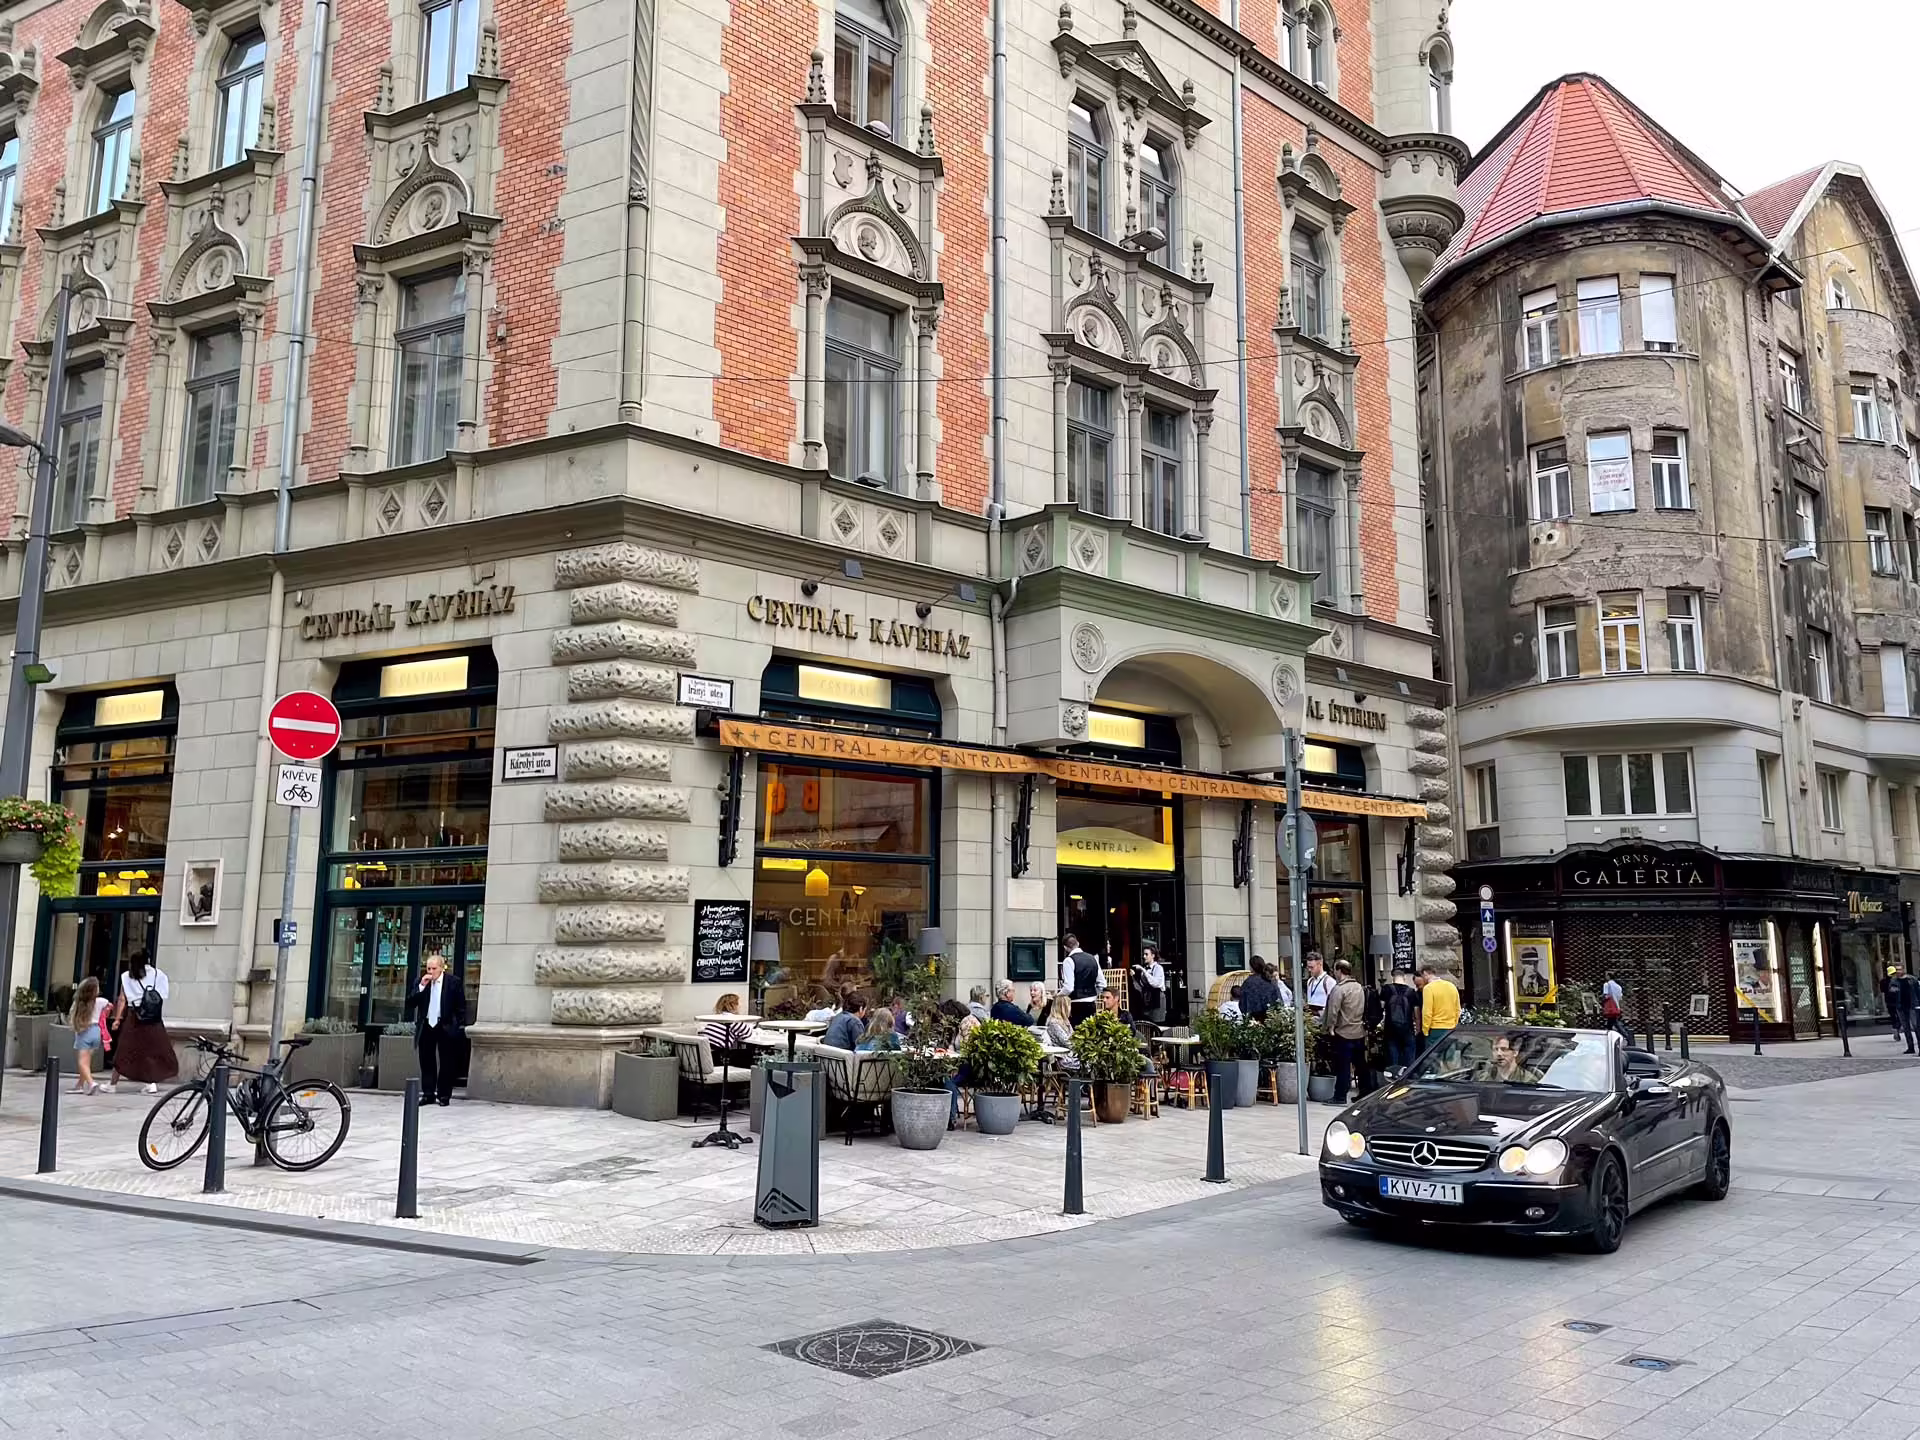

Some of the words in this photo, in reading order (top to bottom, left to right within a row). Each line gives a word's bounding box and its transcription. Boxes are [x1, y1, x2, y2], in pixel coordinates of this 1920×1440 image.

[300, 602, 395, 641] CENTRÁL
[405, 584, 515, 626] KÁVÉHÁZ
[747, 595, 859, 640] CENTRÁL
[869, 618, 971, 659] KÁVÉHÁZ
[1328, 698, 1387, 731] ÉTTEREM
[768, 731, 877, 756] CENTRAL
[510, 757, 534, 770] Károlyi
[536, 758, 551, 768] utca
[923, 747, 1018, 769] CENTRAL
[282, 769, 318, 782] KIVÉVE
[1056, 763, 1134, 784] CENTRAL
[1168, 777, 1240, 795] CENTRAL
[1354, 801, 1409, 814] CENTRAL
[1076, 840, 1131, 853] CENTRAL
[1613, 854, 1657, 867] ERNST
[1574, 867, 1704, 885] GALÉRIA
[789, 907, 883, 927] CENTRAL
[1390, 1180, 1457, 1200] KVV-711
